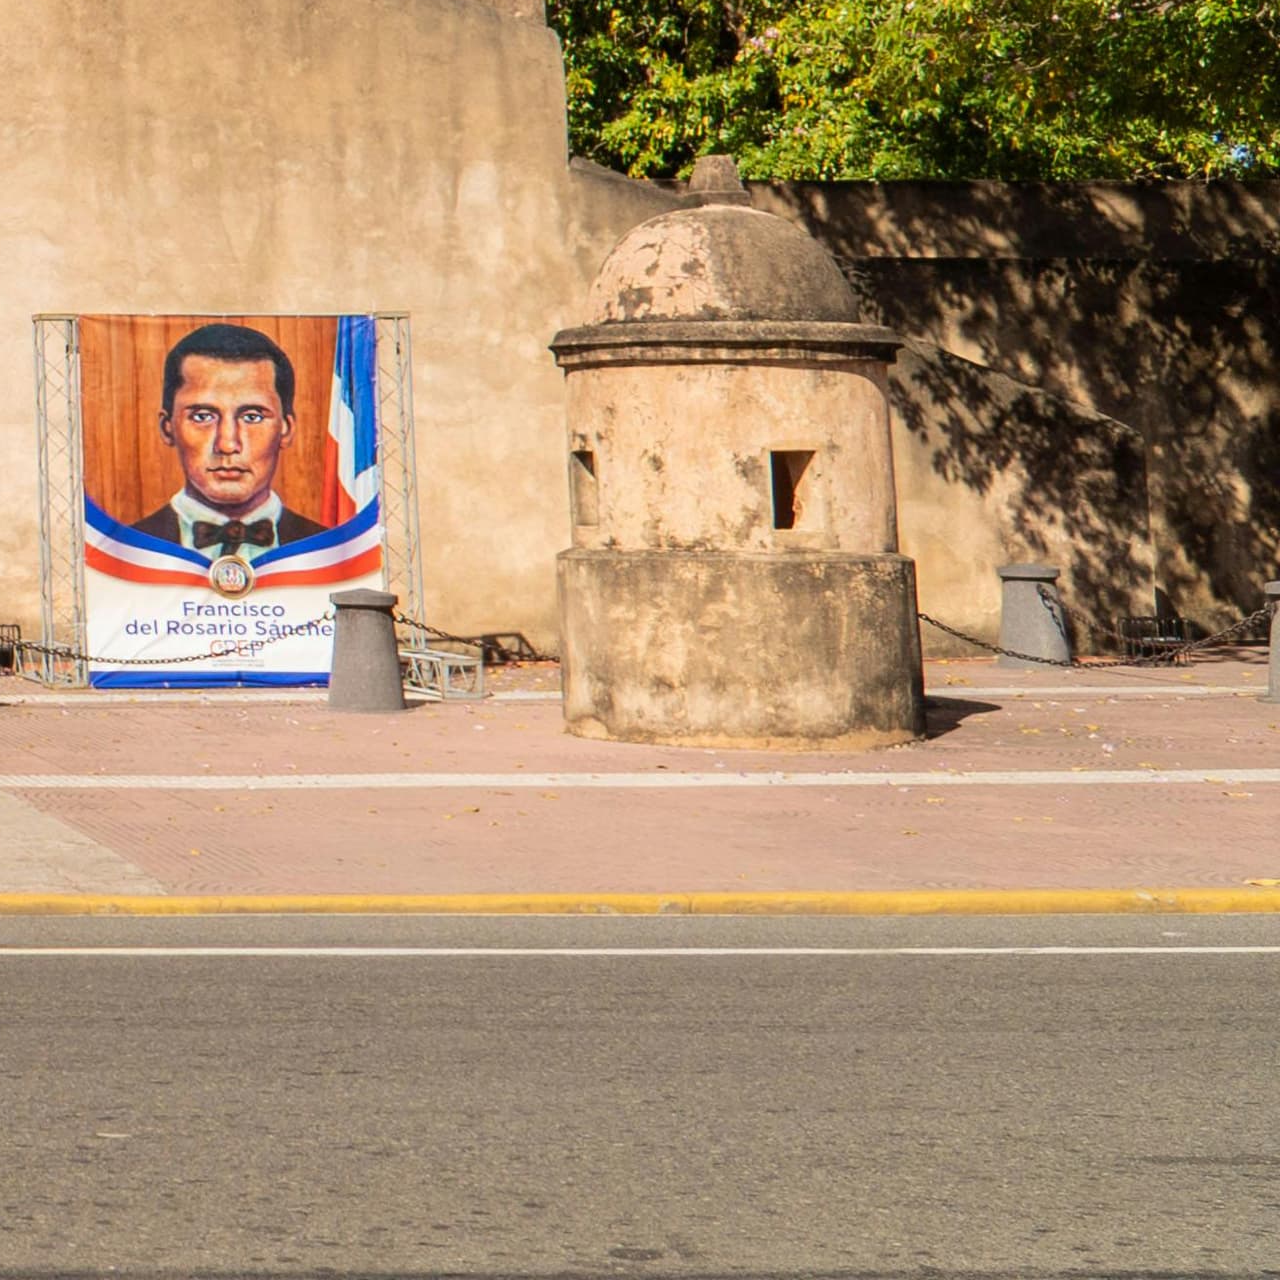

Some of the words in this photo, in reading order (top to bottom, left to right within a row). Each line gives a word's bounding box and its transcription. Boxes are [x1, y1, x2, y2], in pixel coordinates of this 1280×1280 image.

[183, 601, 285, 617] Francisco
[125, 620, 158, 636] del
[167, 620, 247, 636] Rosario
[255, 619, 333, 637] Sánche
